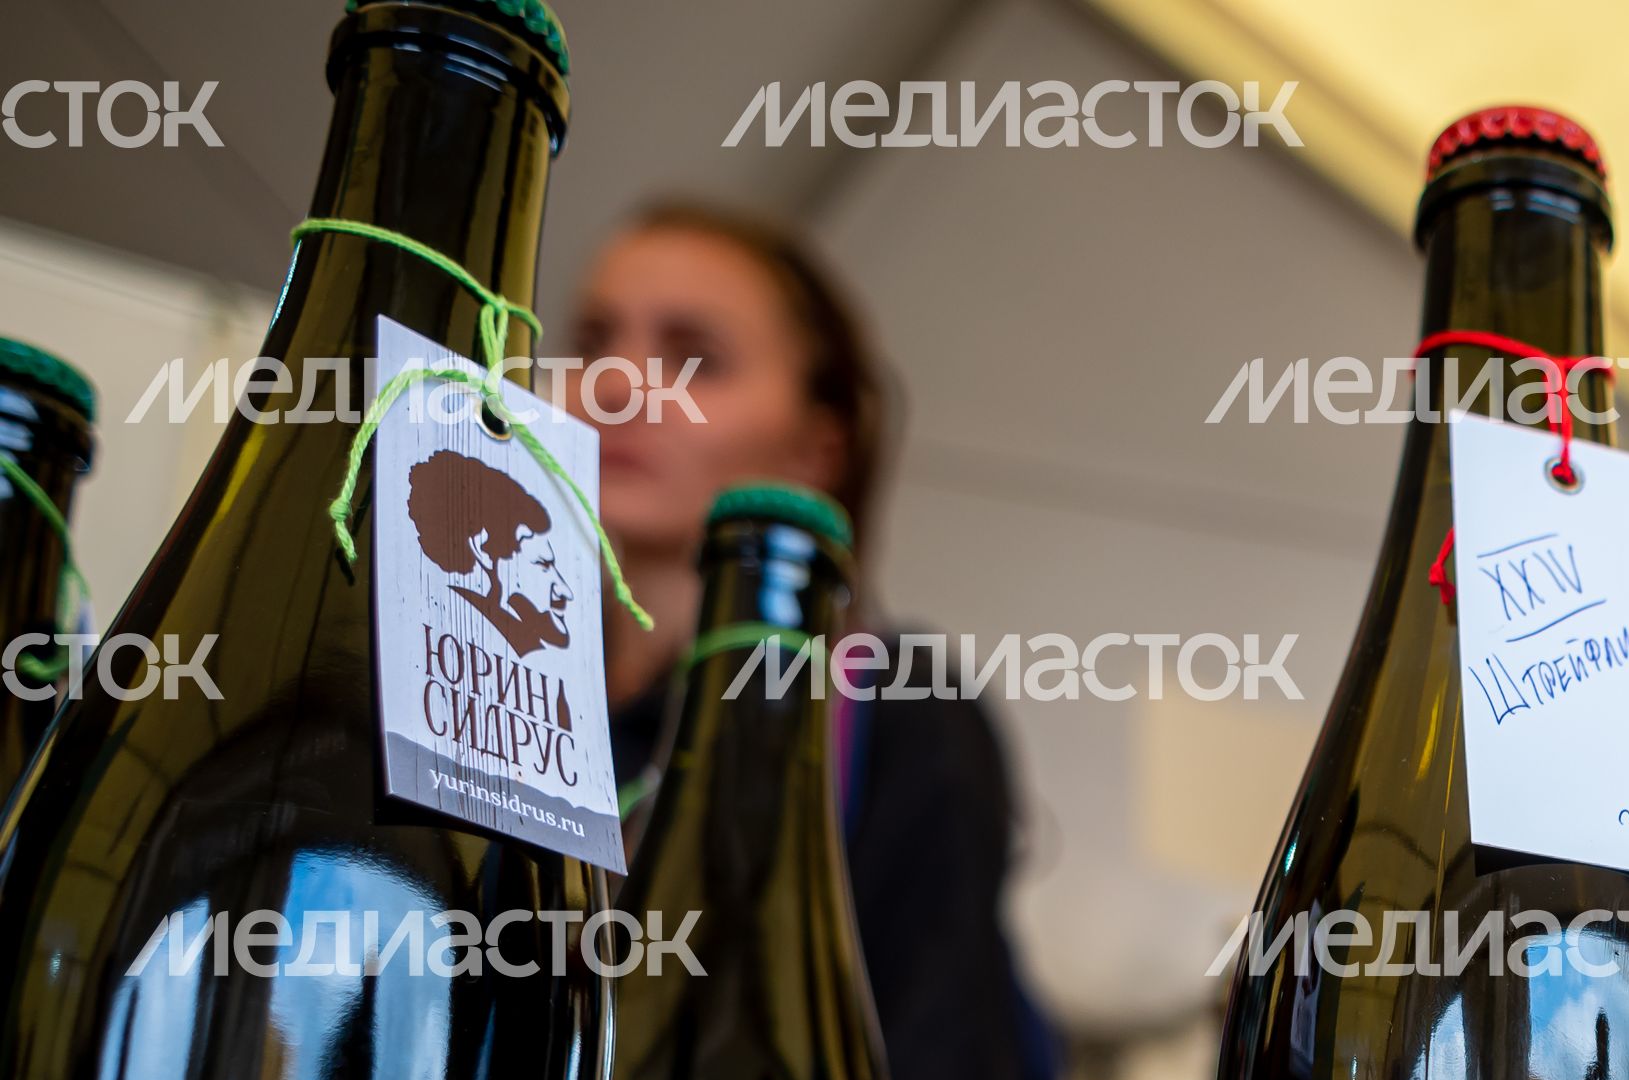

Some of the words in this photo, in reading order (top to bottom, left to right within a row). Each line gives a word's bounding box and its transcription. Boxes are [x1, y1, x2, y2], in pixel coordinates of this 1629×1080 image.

[422, 623, 553, 726] ЮРИН
[423, 680, 578, 787] СИДРУС
[429, 768, 585, 838] yurinsidrus.ru
